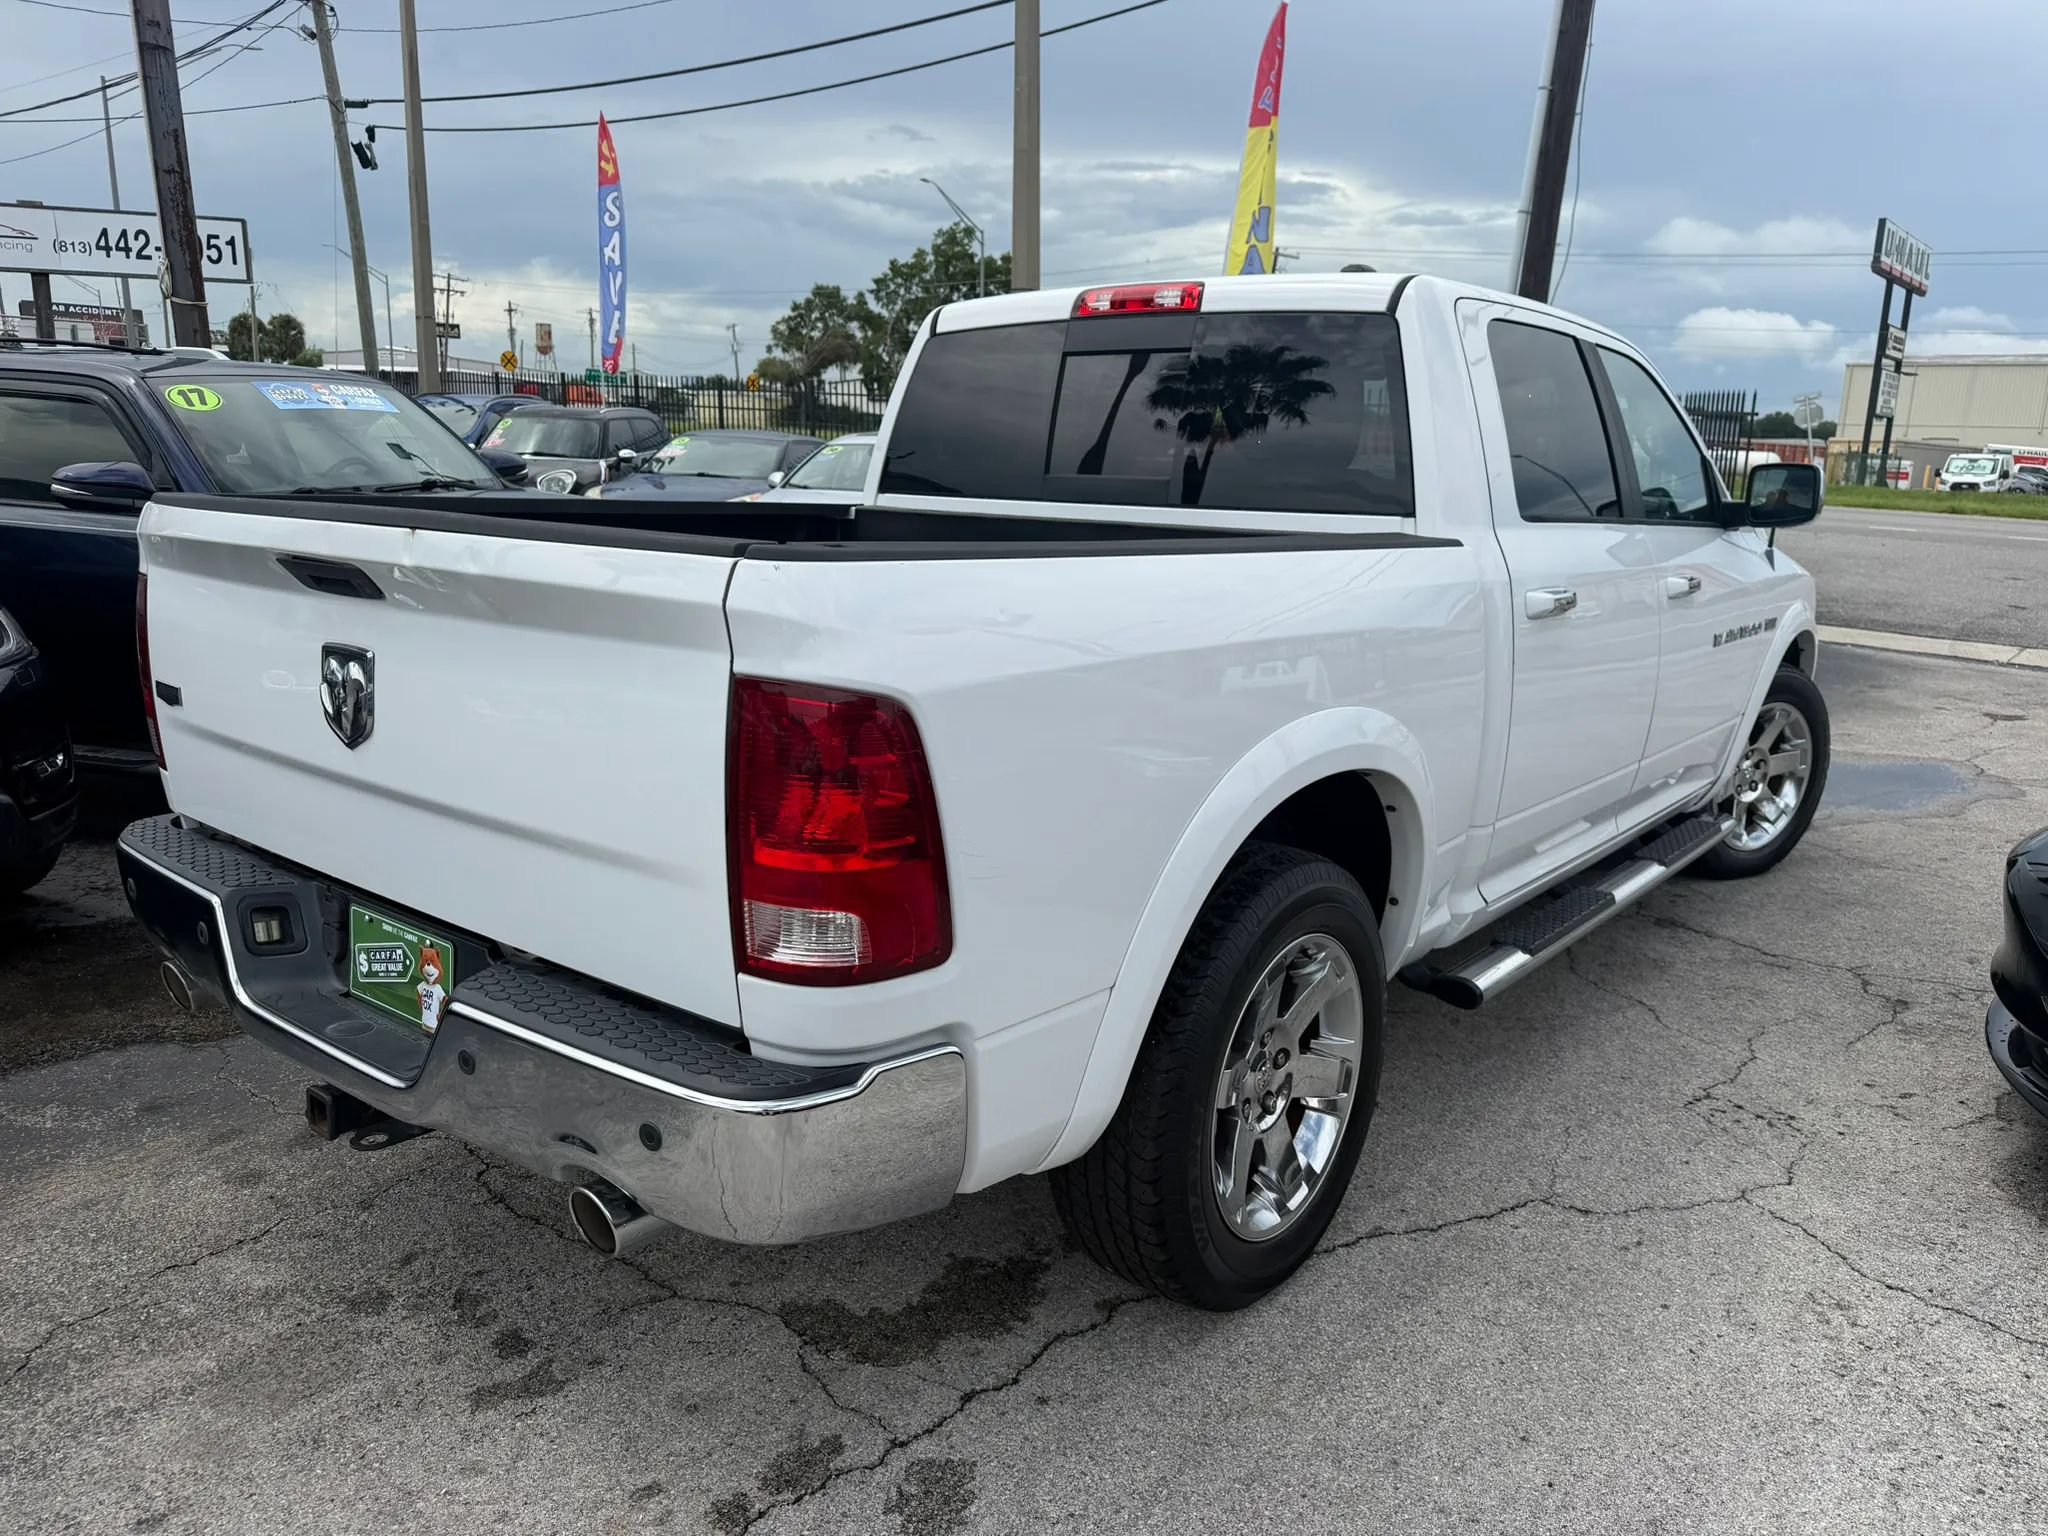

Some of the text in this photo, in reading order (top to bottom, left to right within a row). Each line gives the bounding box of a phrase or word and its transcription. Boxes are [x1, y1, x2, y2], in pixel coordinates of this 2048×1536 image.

[53, 227, 238, 266] (813) 442-51
[177, 388, 208, 407] 17
[371, 962, 403, 971] GREAT VALUE
